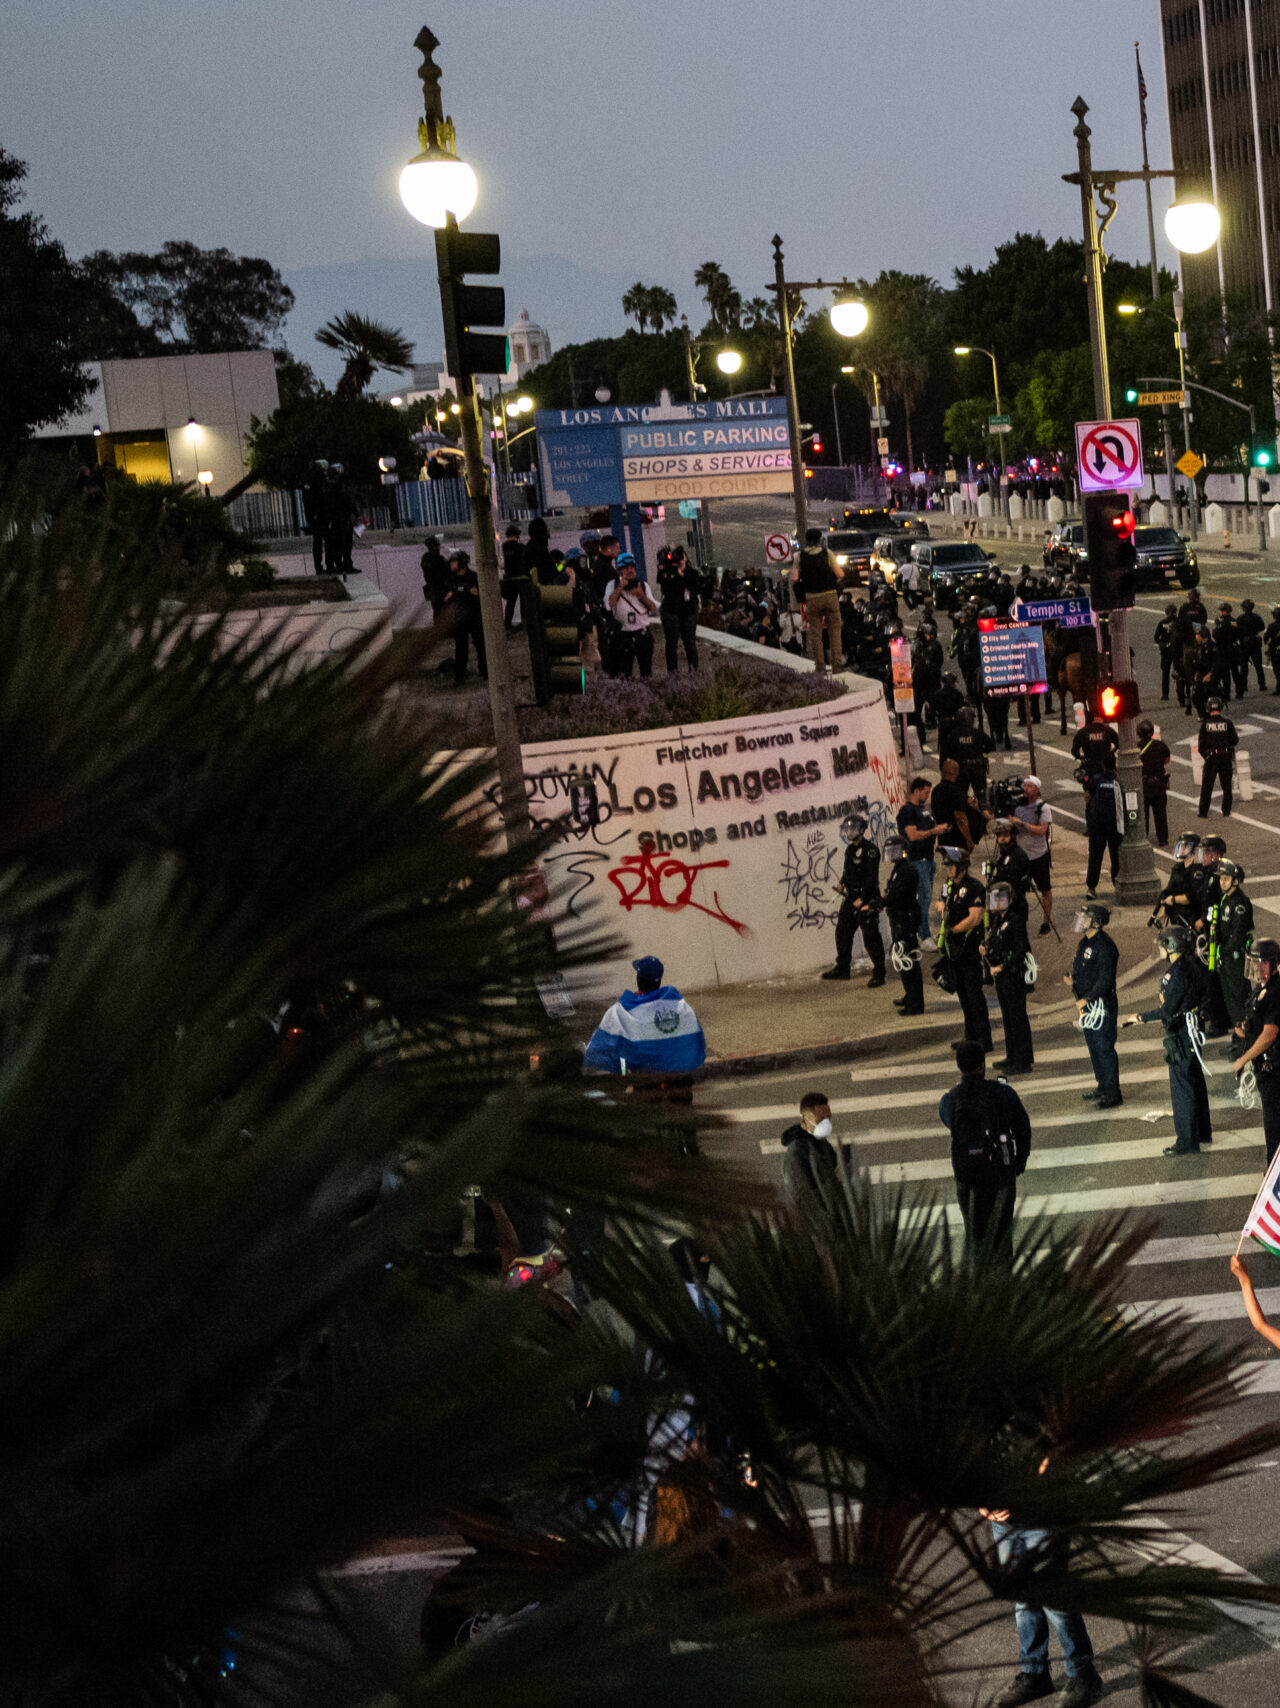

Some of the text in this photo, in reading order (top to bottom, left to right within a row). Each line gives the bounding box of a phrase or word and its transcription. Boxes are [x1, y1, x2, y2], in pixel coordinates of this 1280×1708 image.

[560, 409, 601, 426] LOS
[715, 400, 773, 417] MALL
[627, 426, 787, 449] PUBLIC PARKING
[627, 459, 688, 476] SHOPS
[693, 458, 704, 472] &
[654, 476, 769, 497] FOOD COURT
[1026, 601, 1081, 618] Temple St
[1066, 616, 1078, 626] 100
[1208, 723, 1226, 731] POLICE
[656, 724, 840, 766] Fletcher Bowron Square
[609, 780, 679, 815] Los
[697, 757, 821, 803] Angeles
[831, 740, 869, 779] Mall
[638, 826, 718, 853] Shops
[726, 813, 767, 840] and
[775, 794, 869, 834] Restaurants
